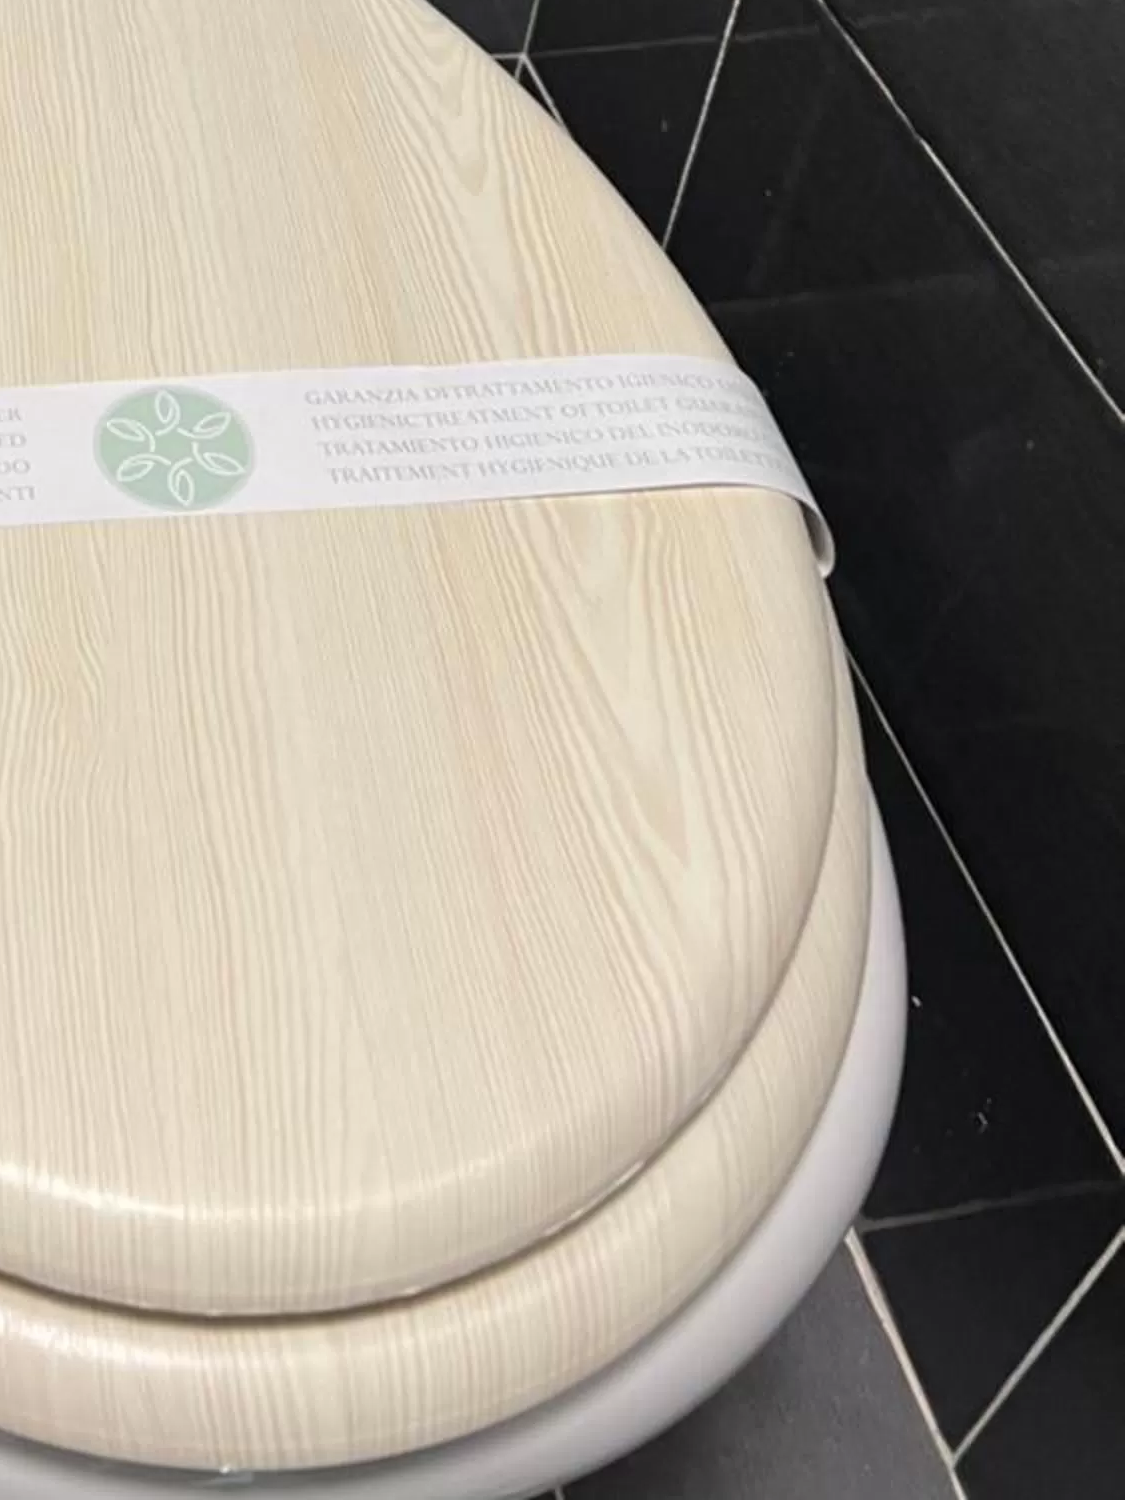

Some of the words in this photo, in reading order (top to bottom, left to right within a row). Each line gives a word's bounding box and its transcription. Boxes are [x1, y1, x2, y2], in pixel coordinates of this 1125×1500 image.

[305, 386, 419, 406] GARANZIA
[448, 377, 614, 401] TRATTAMENTO
[311, 411, 422, 432] HYGIENIC
[423, 405, 555, 428] TREATMENT
[560, 402, 587, 418] OF
[593, 396, 668, 417] TOILET
[317, 435, 479, 458] TRATAMIENTO
[483, 427, 604, 450] HIGIENICO
[330, 461, 473, 485] TRAITEMENT
[477, 452, 618, 477] HYGIENIQUE
